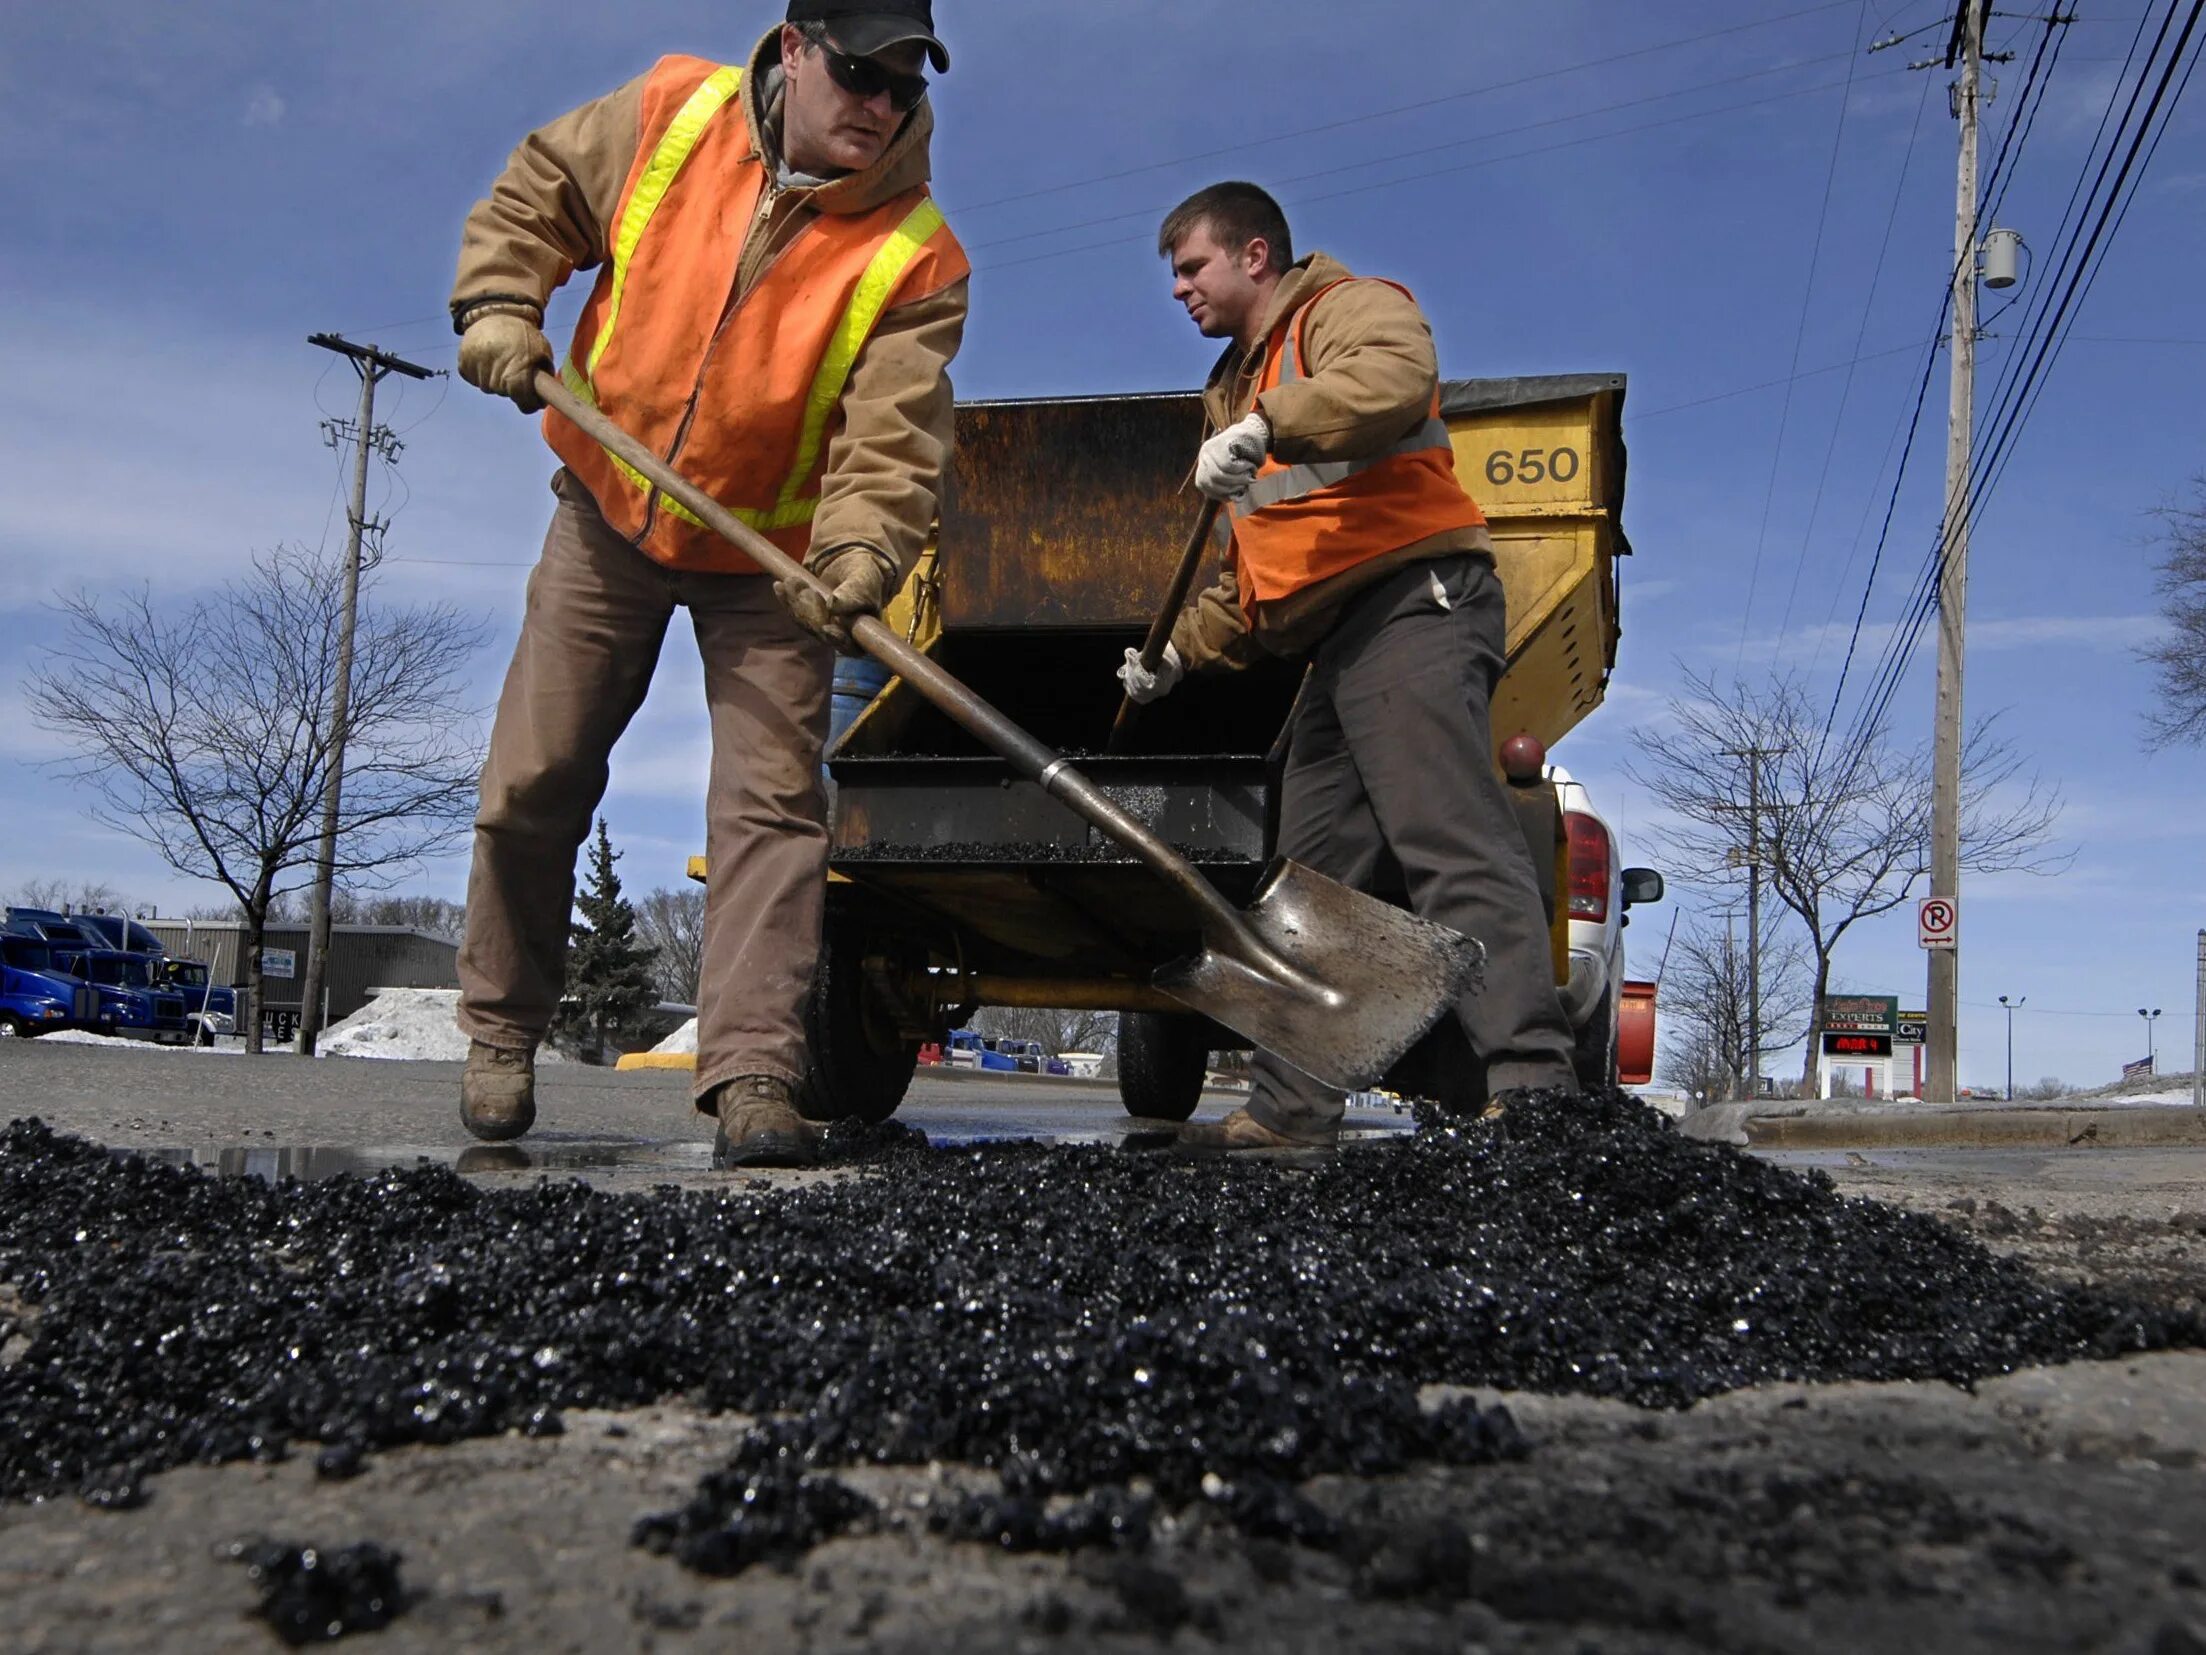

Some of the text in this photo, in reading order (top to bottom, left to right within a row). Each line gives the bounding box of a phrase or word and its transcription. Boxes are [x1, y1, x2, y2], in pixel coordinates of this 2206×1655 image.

[1485, 446, 1579, 486] 650
[1831, 1013, 1884, 1022] EXPERTS
[1900, 1024, 1923, 1038] City
